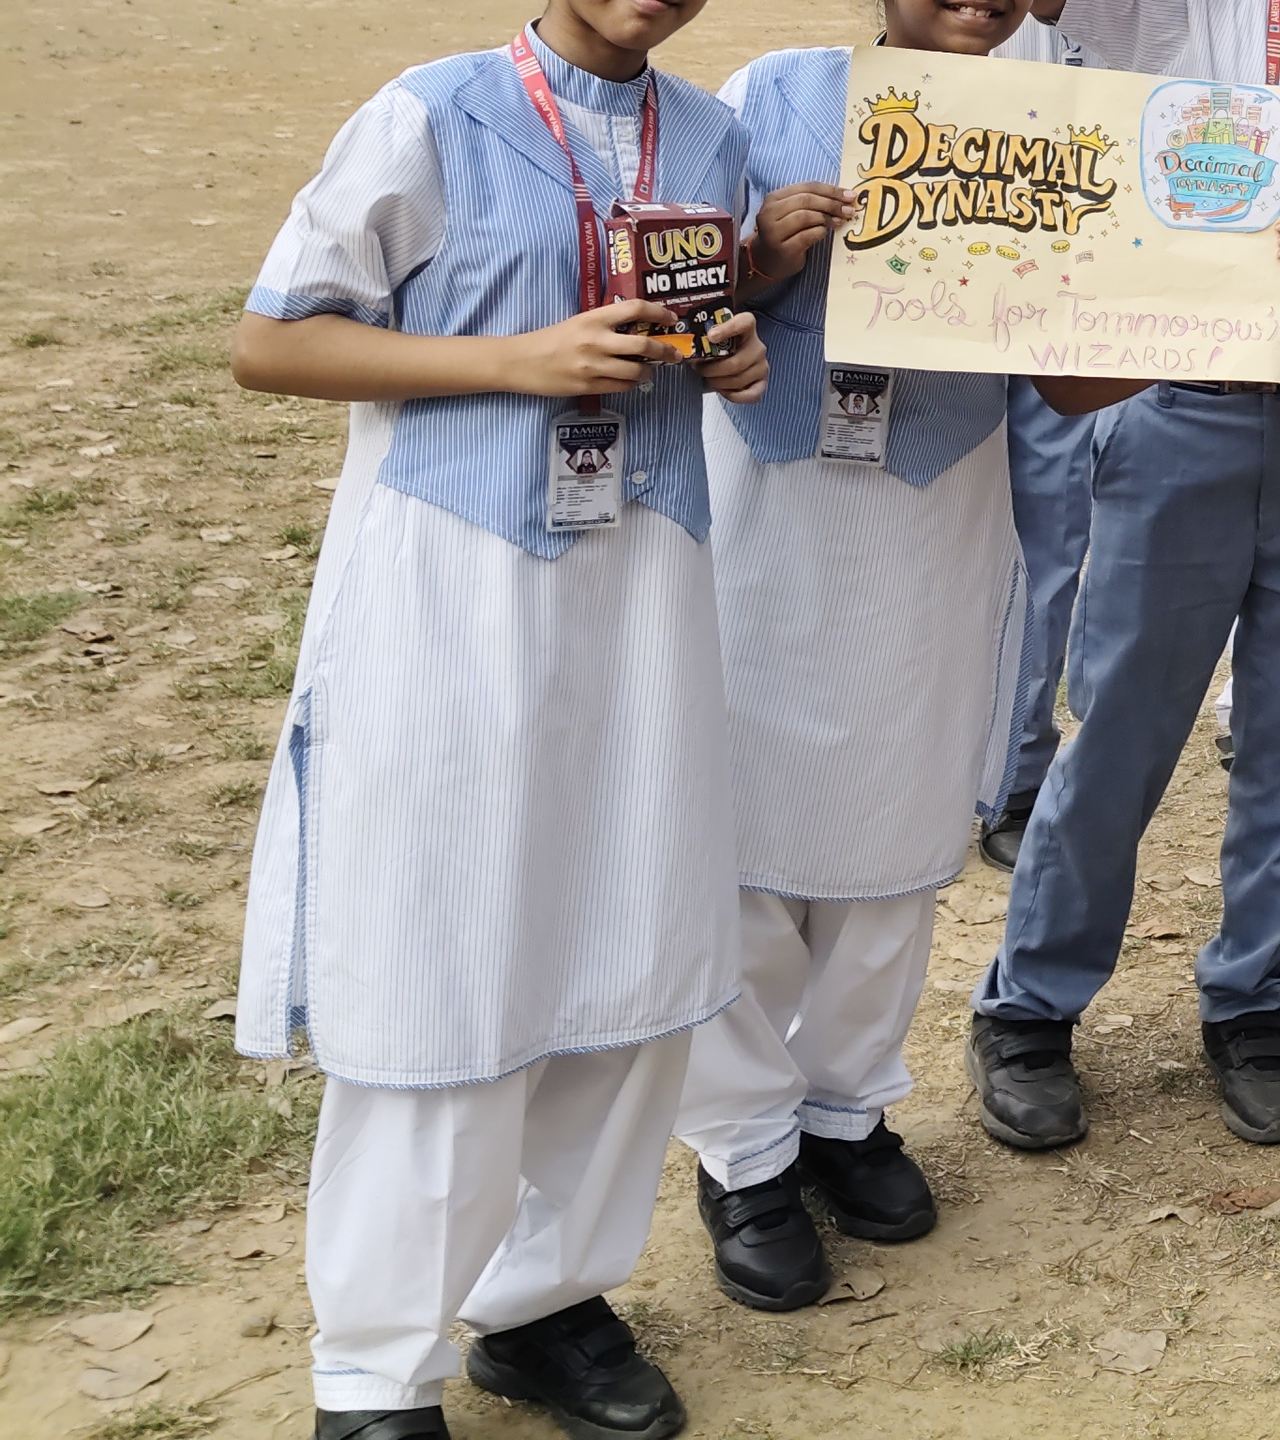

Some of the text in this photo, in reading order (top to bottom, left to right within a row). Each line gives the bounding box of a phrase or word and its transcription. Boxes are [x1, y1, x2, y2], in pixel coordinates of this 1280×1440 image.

[643, 110, 656, 185] AMRITA VIDYALAYAM
[857, 111, 1119, 201] DECIMAL
[1154, 150, 1265, 182] Decimal
[1176, 178, 1250, 196] DYNASTY
[843, 176, 1111, 251] DYNASTY
[584, 221, 594, 276] VIDYALAYAM
[615, 228, 633, 274] UNO
[644, 223, 722, 268] UNO
[646, 264, 727, 294] NO MERCY
[852, 279, 976, 331] Tools
[988, 283, 1049, 352] for
[845, 372, 885, 382] AMRITA
[572, 425, 615, 434] AMRITA
